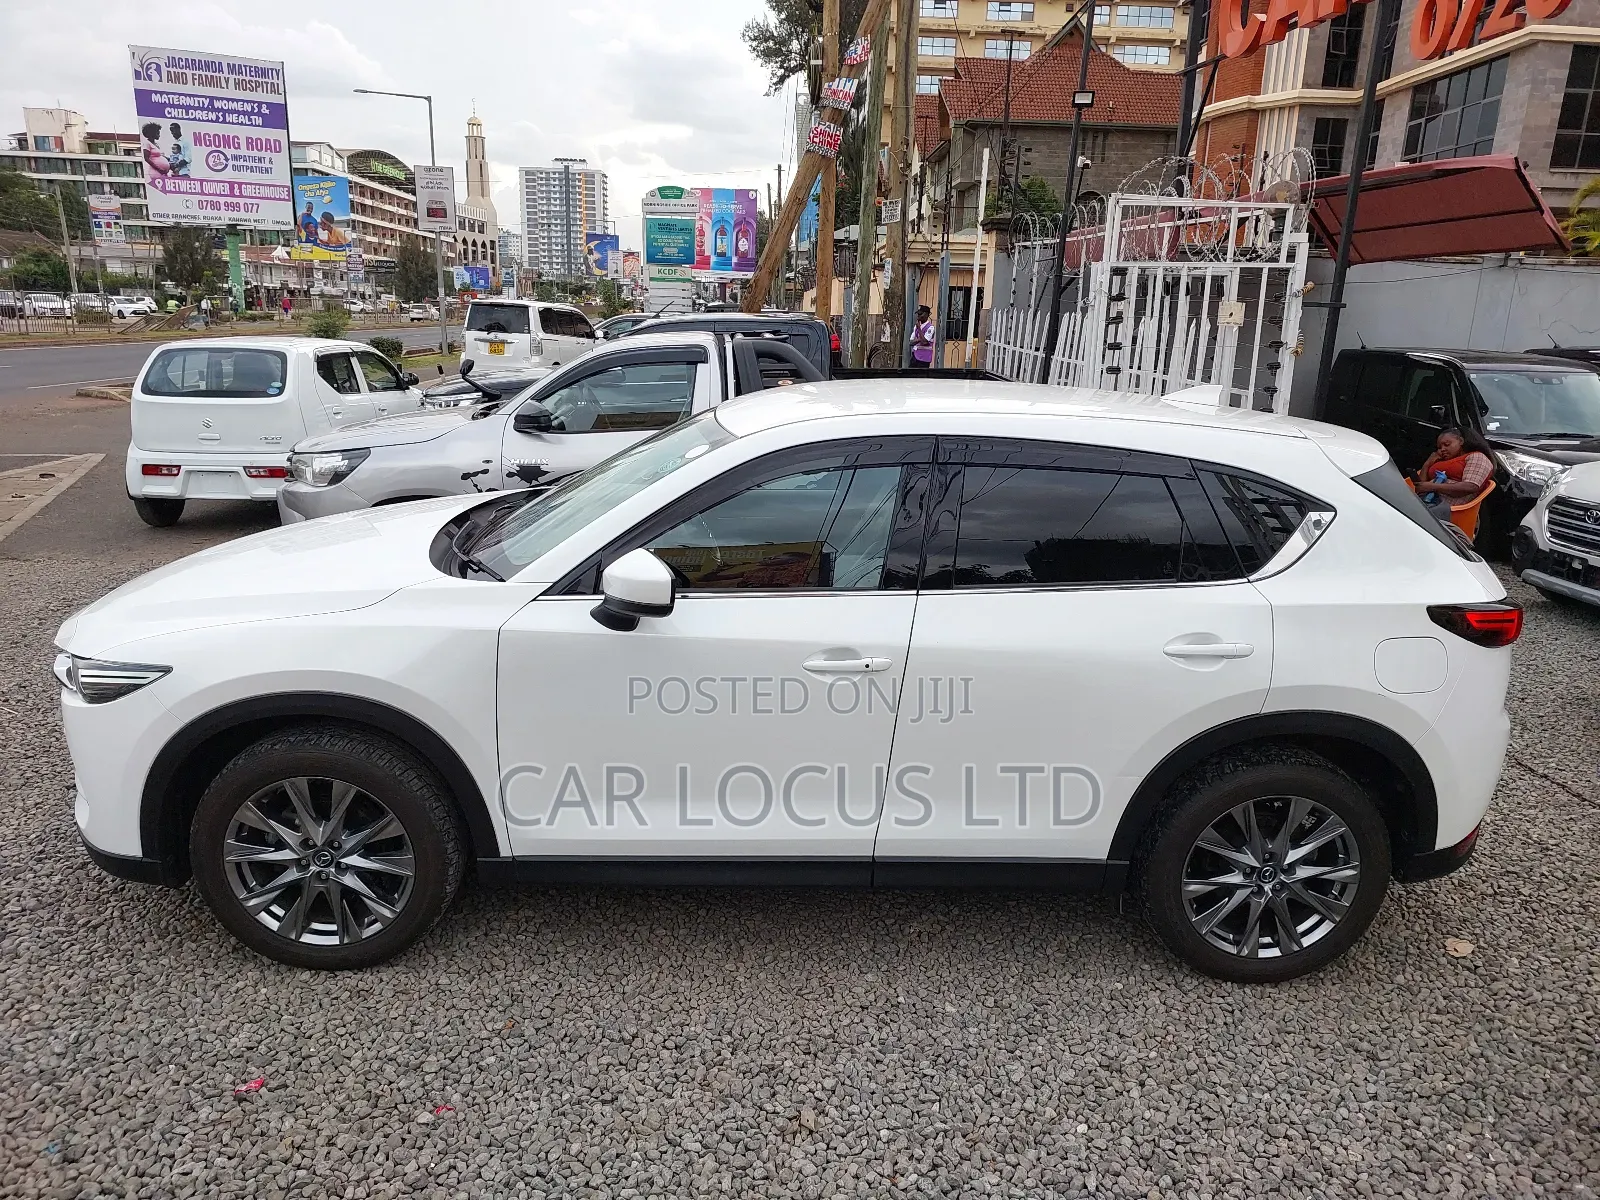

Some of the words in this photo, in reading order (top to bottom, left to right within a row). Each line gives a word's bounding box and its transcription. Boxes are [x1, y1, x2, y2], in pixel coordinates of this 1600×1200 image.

[165, 56, 224, 74] JACARANDA
[227, 63, 280, 80] MATERNITY
[167, 71, 188, 85] AND
[191, 73, 230, 89] FAMILY
[234, 78, 282, 95] HOSPITAL
[151, 93, 211, 109] MATERNITY,
[214, 99, 258, 112] WOMEN'S
[261, 104, 269, 114] &
[165, 108, 223, 122] CHILDREN'S
[226, 114, 262, 126] HEALTH
[193, 132, 241, 150] NGONG
[246, 136, 282, 153] ROAD
[231, 154, 266, 164] INPATIENT
[269, 157, 273, 165] &
[232, 164, 273, 174] OUTPATIENT
[165, 179, 201, 193] BETWEEN
[203, 181, 230, 195] QUIVER
[234, 184, 240, 195] &
[242, 185, 289, 199] GREENHOUSE
[198, 200, 220, 211] 0780
[224, 201, 241, 212] 999
[243, 203, 259, 213] 077
[658, 267, 678, 276] KCDF
